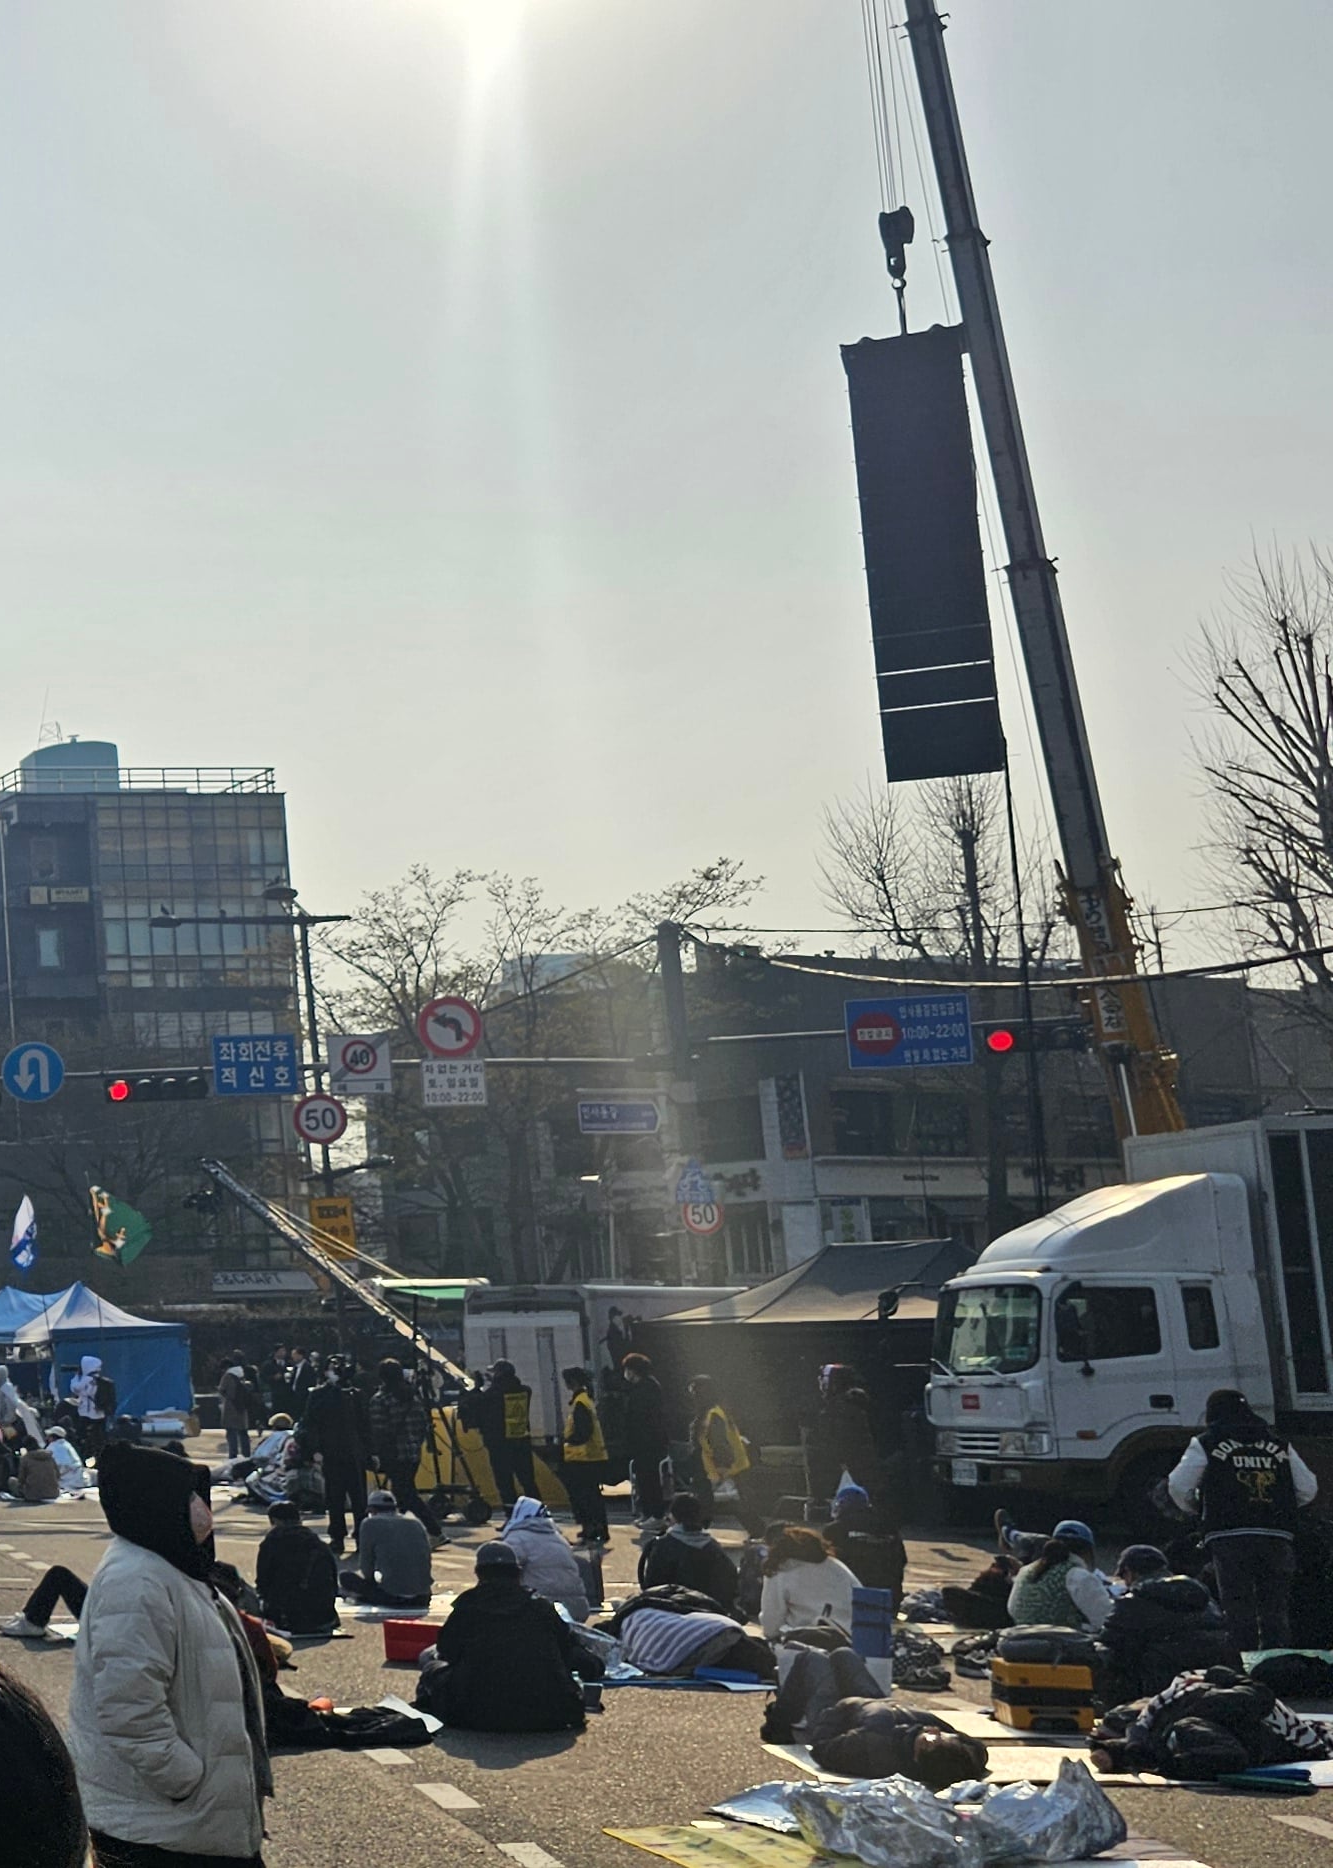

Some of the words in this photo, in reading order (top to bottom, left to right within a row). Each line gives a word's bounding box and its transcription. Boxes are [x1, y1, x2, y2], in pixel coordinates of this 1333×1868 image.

[219, 1040, 290, 1062] 좌회전후
[349, 1050, 370, 1066] 40
[304, 1107, 337, 1131] 50
[691, 1204, 715, 1226] 50
[1233, 1455, 1277, 1469] UNIV.
